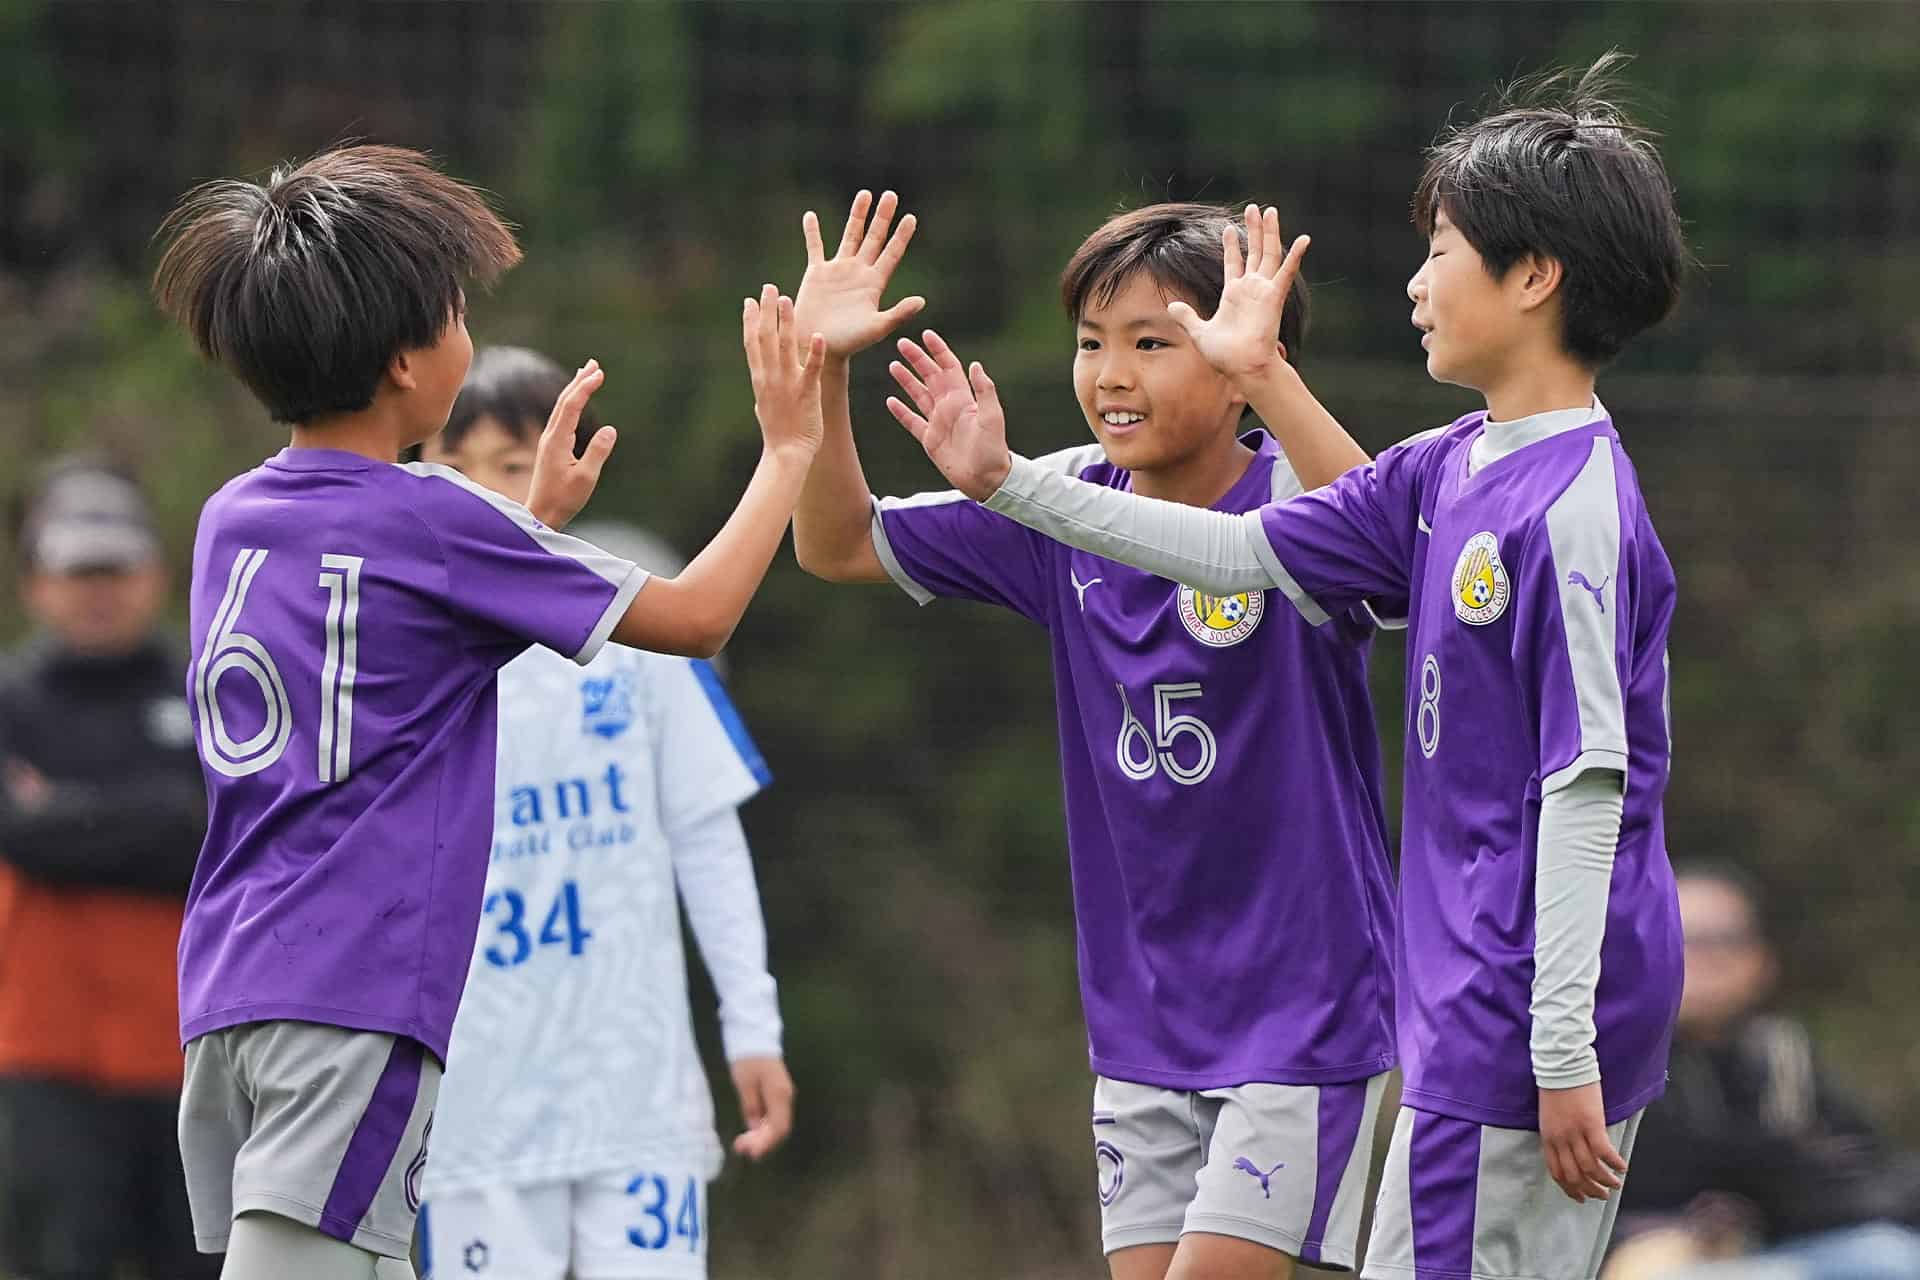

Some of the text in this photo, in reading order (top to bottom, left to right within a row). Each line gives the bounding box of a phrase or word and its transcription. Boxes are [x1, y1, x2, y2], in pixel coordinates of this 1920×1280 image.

[198, 548, 367, 784] 61
[1182, 599, 1206, 635] SUMIRE
[1208, 620, 1251, 641] SOCCER
[1115, 681, 1218, 785] 65
[1416, 653, 1442, 760] 8
[483, 880, 594, 967] 34
[625, 1170, 700, 1254] 34
